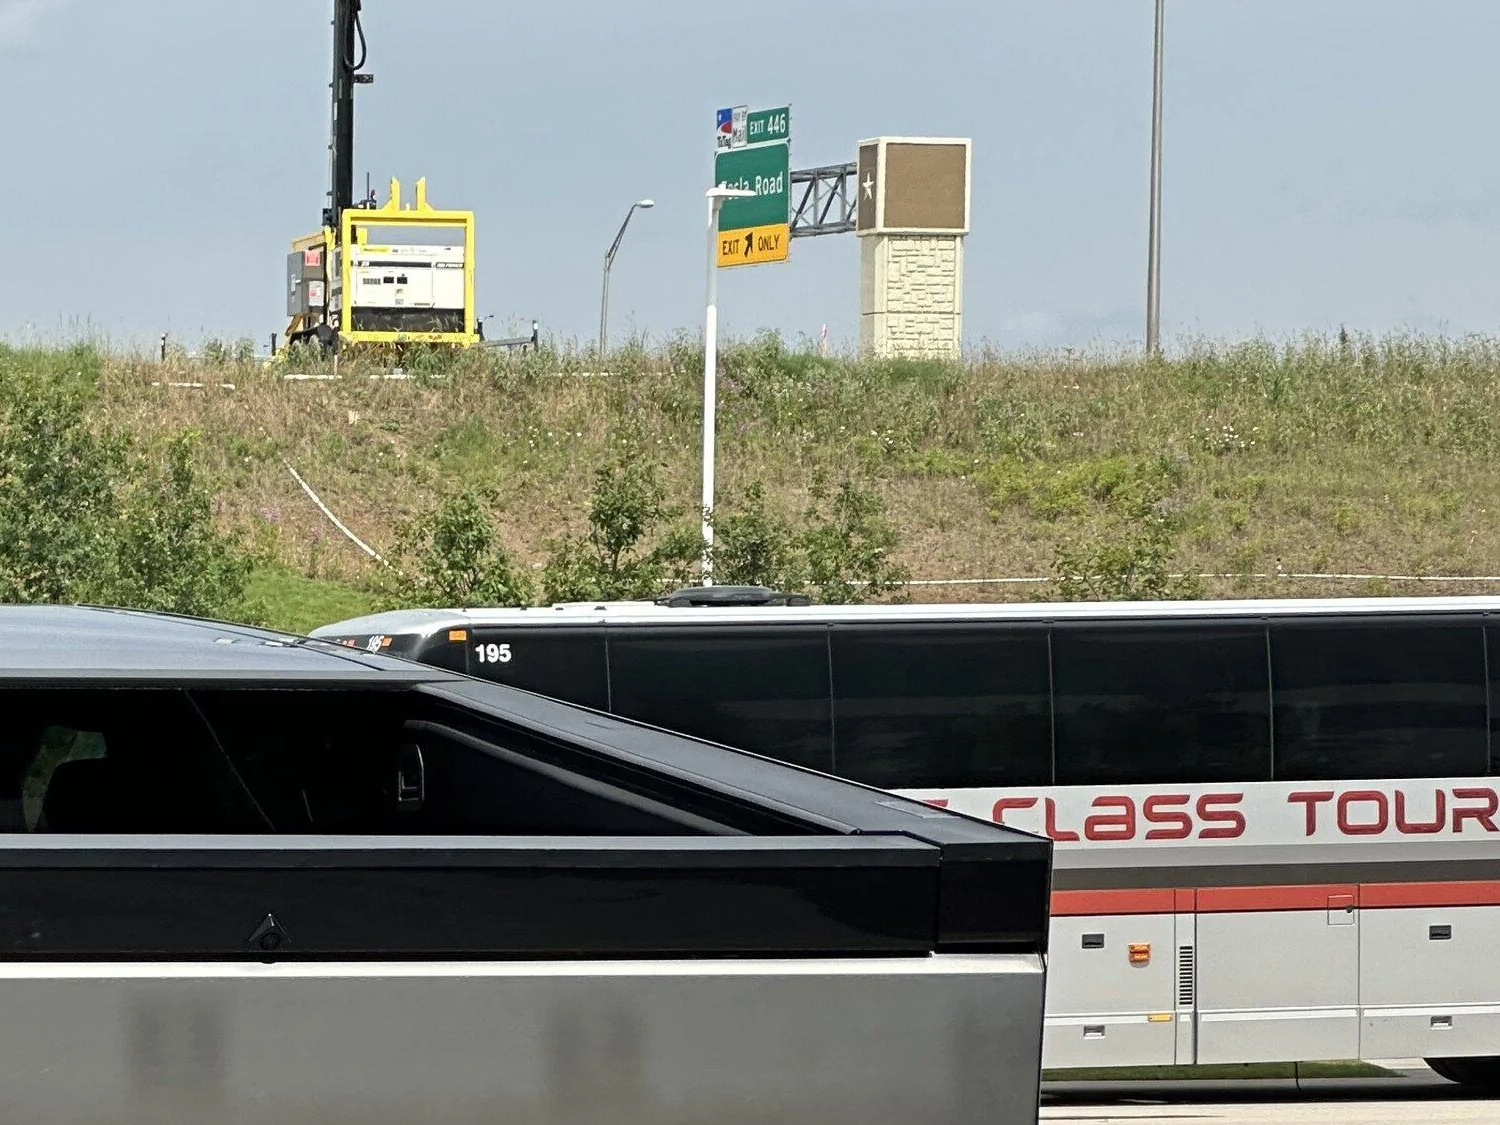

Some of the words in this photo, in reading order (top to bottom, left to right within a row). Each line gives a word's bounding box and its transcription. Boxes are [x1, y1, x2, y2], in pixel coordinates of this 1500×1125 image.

[749, 120, 764, 135] EXIT
[767, 113, 786, 134] 446
[755, 171, 783, 196] Road
[722, 239, 740, 255] EXIT
[757, 234, 780, 252] ONLY
[475, 643, 512, 663] 195
[1287, 788, 1500, 837] TOUR
